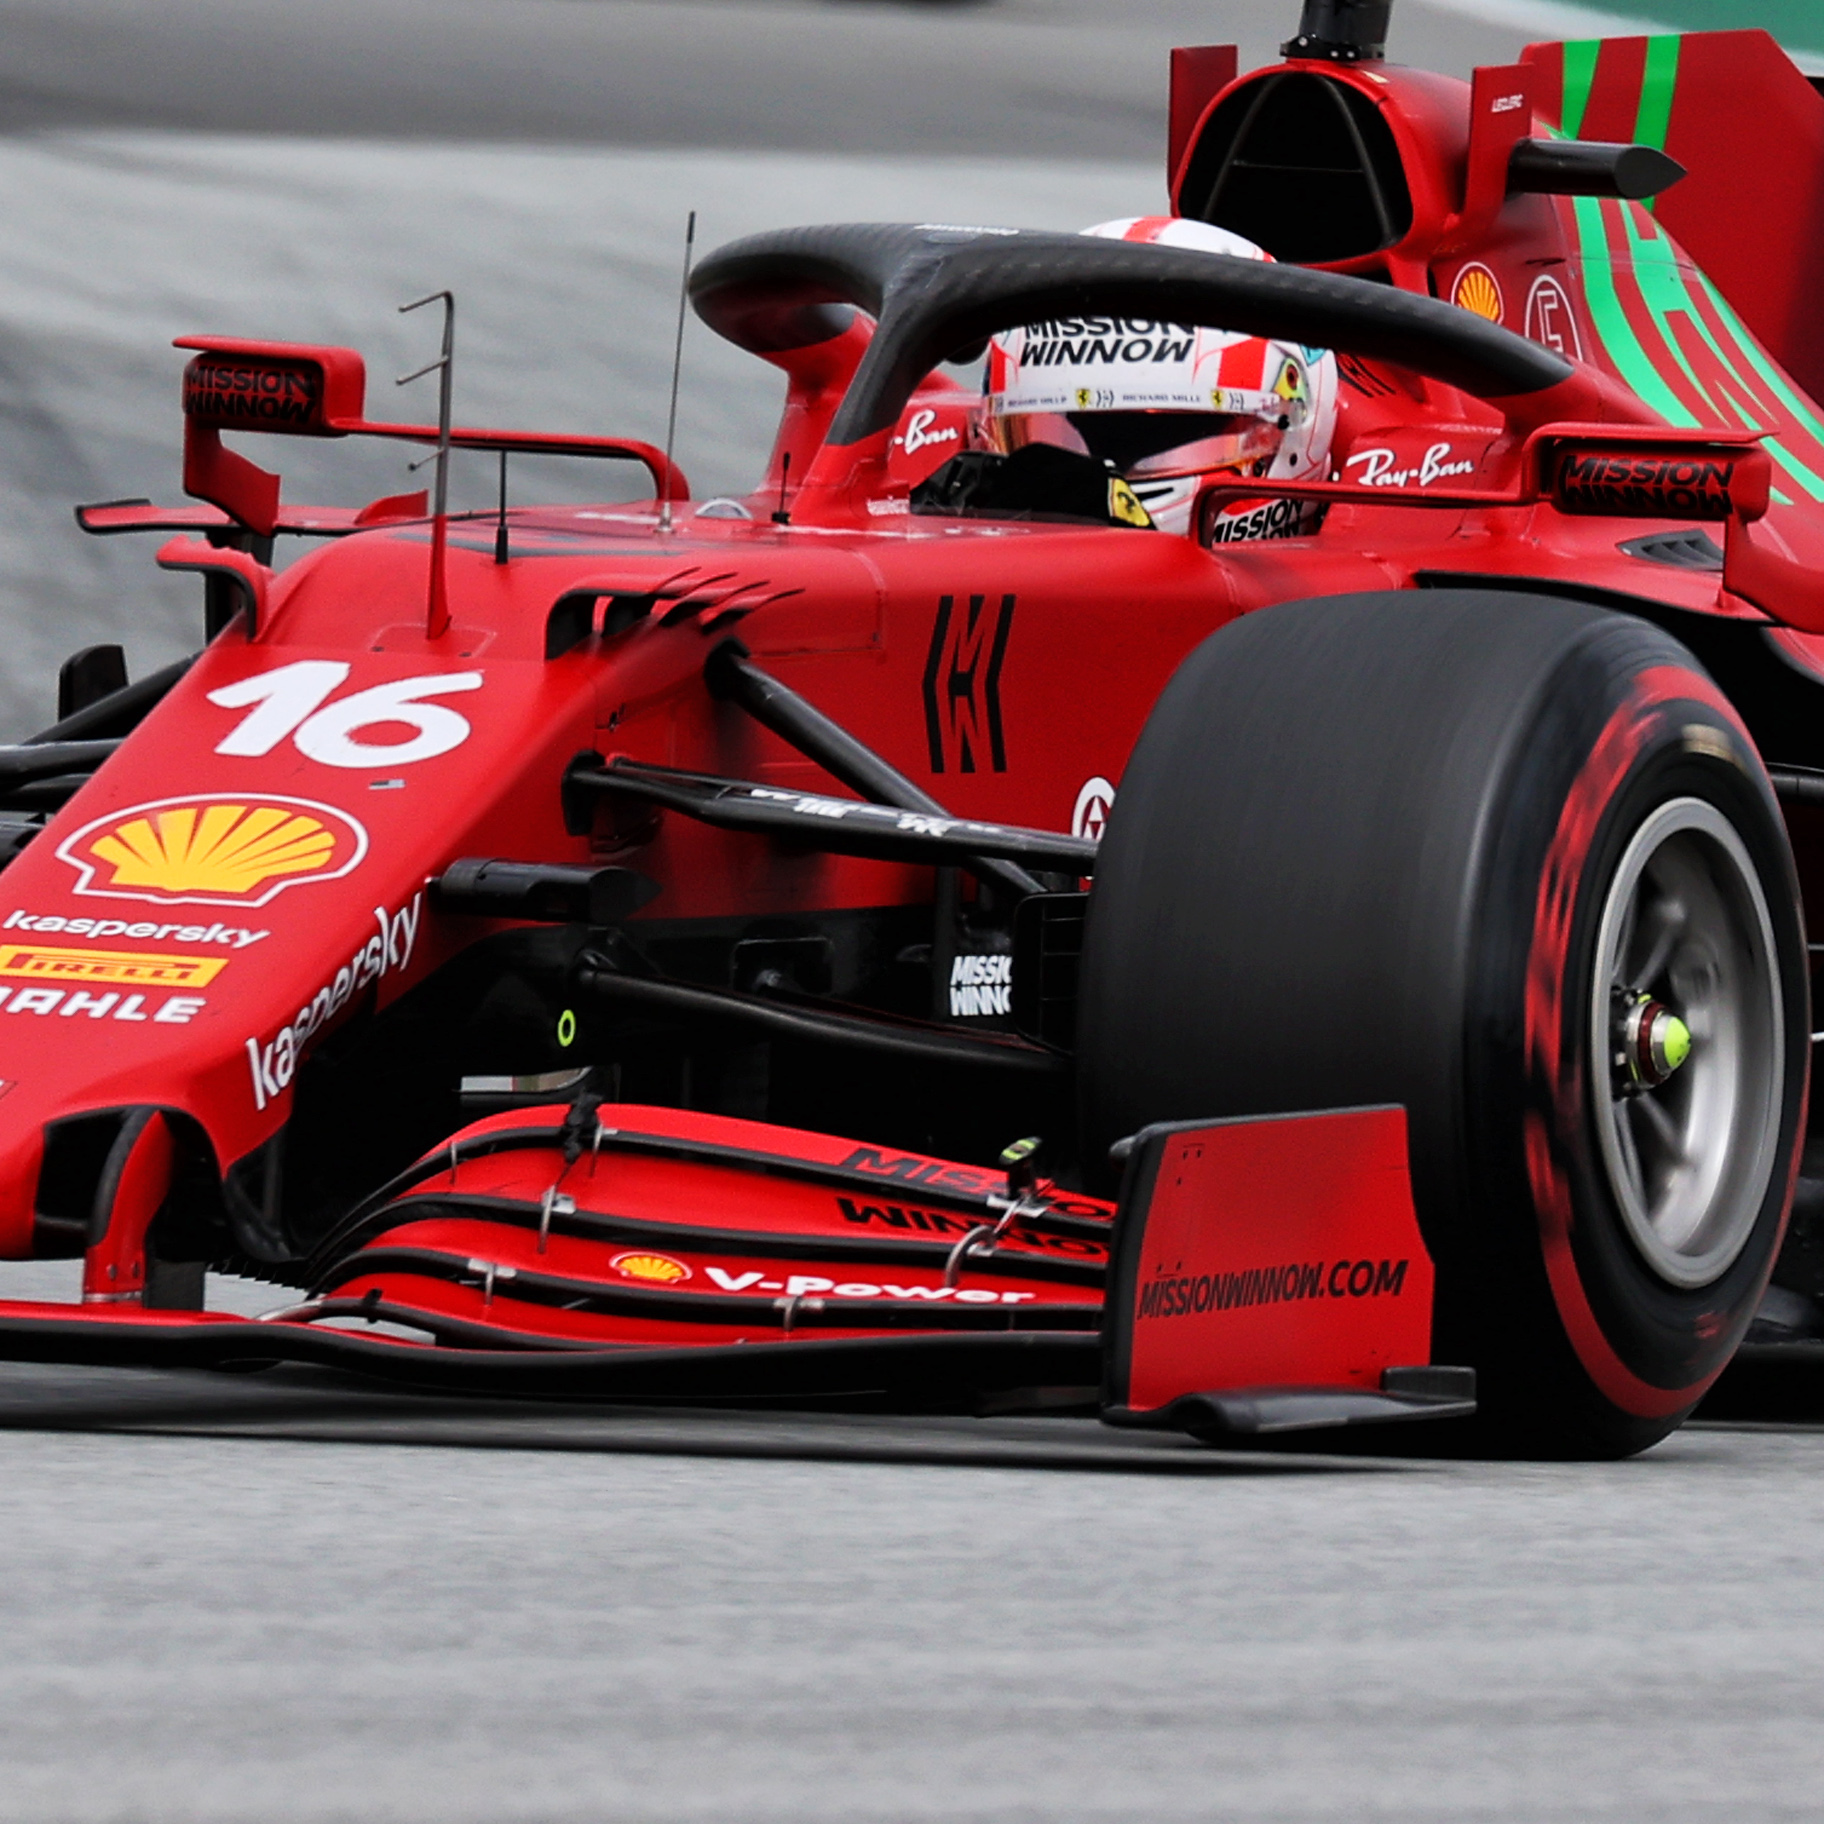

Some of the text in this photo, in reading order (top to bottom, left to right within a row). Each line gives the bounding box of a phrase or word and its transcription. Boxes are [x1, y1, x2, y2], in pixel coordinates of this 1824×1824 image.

[1020, 338, 1198, 368] WINNOW
[184, 365, 317, 398] MISSION
[185, 391, 317, 424] WINNOW
[1345, 441, 1475, 488] Ray-Ban
[1562, 454, 1734, 488] MISSION
[206, 659, 484, 769] 16
[3, 909, 271, 949] kaspersky
[5, 952, 201, 981] PIRELLI
[245, 891, 422, 1112] kaspersky
[704, 1266, 1037, 1304] V-Power
[1136, 1259, 1410, 1320] MISSIONWINNOW.COM
